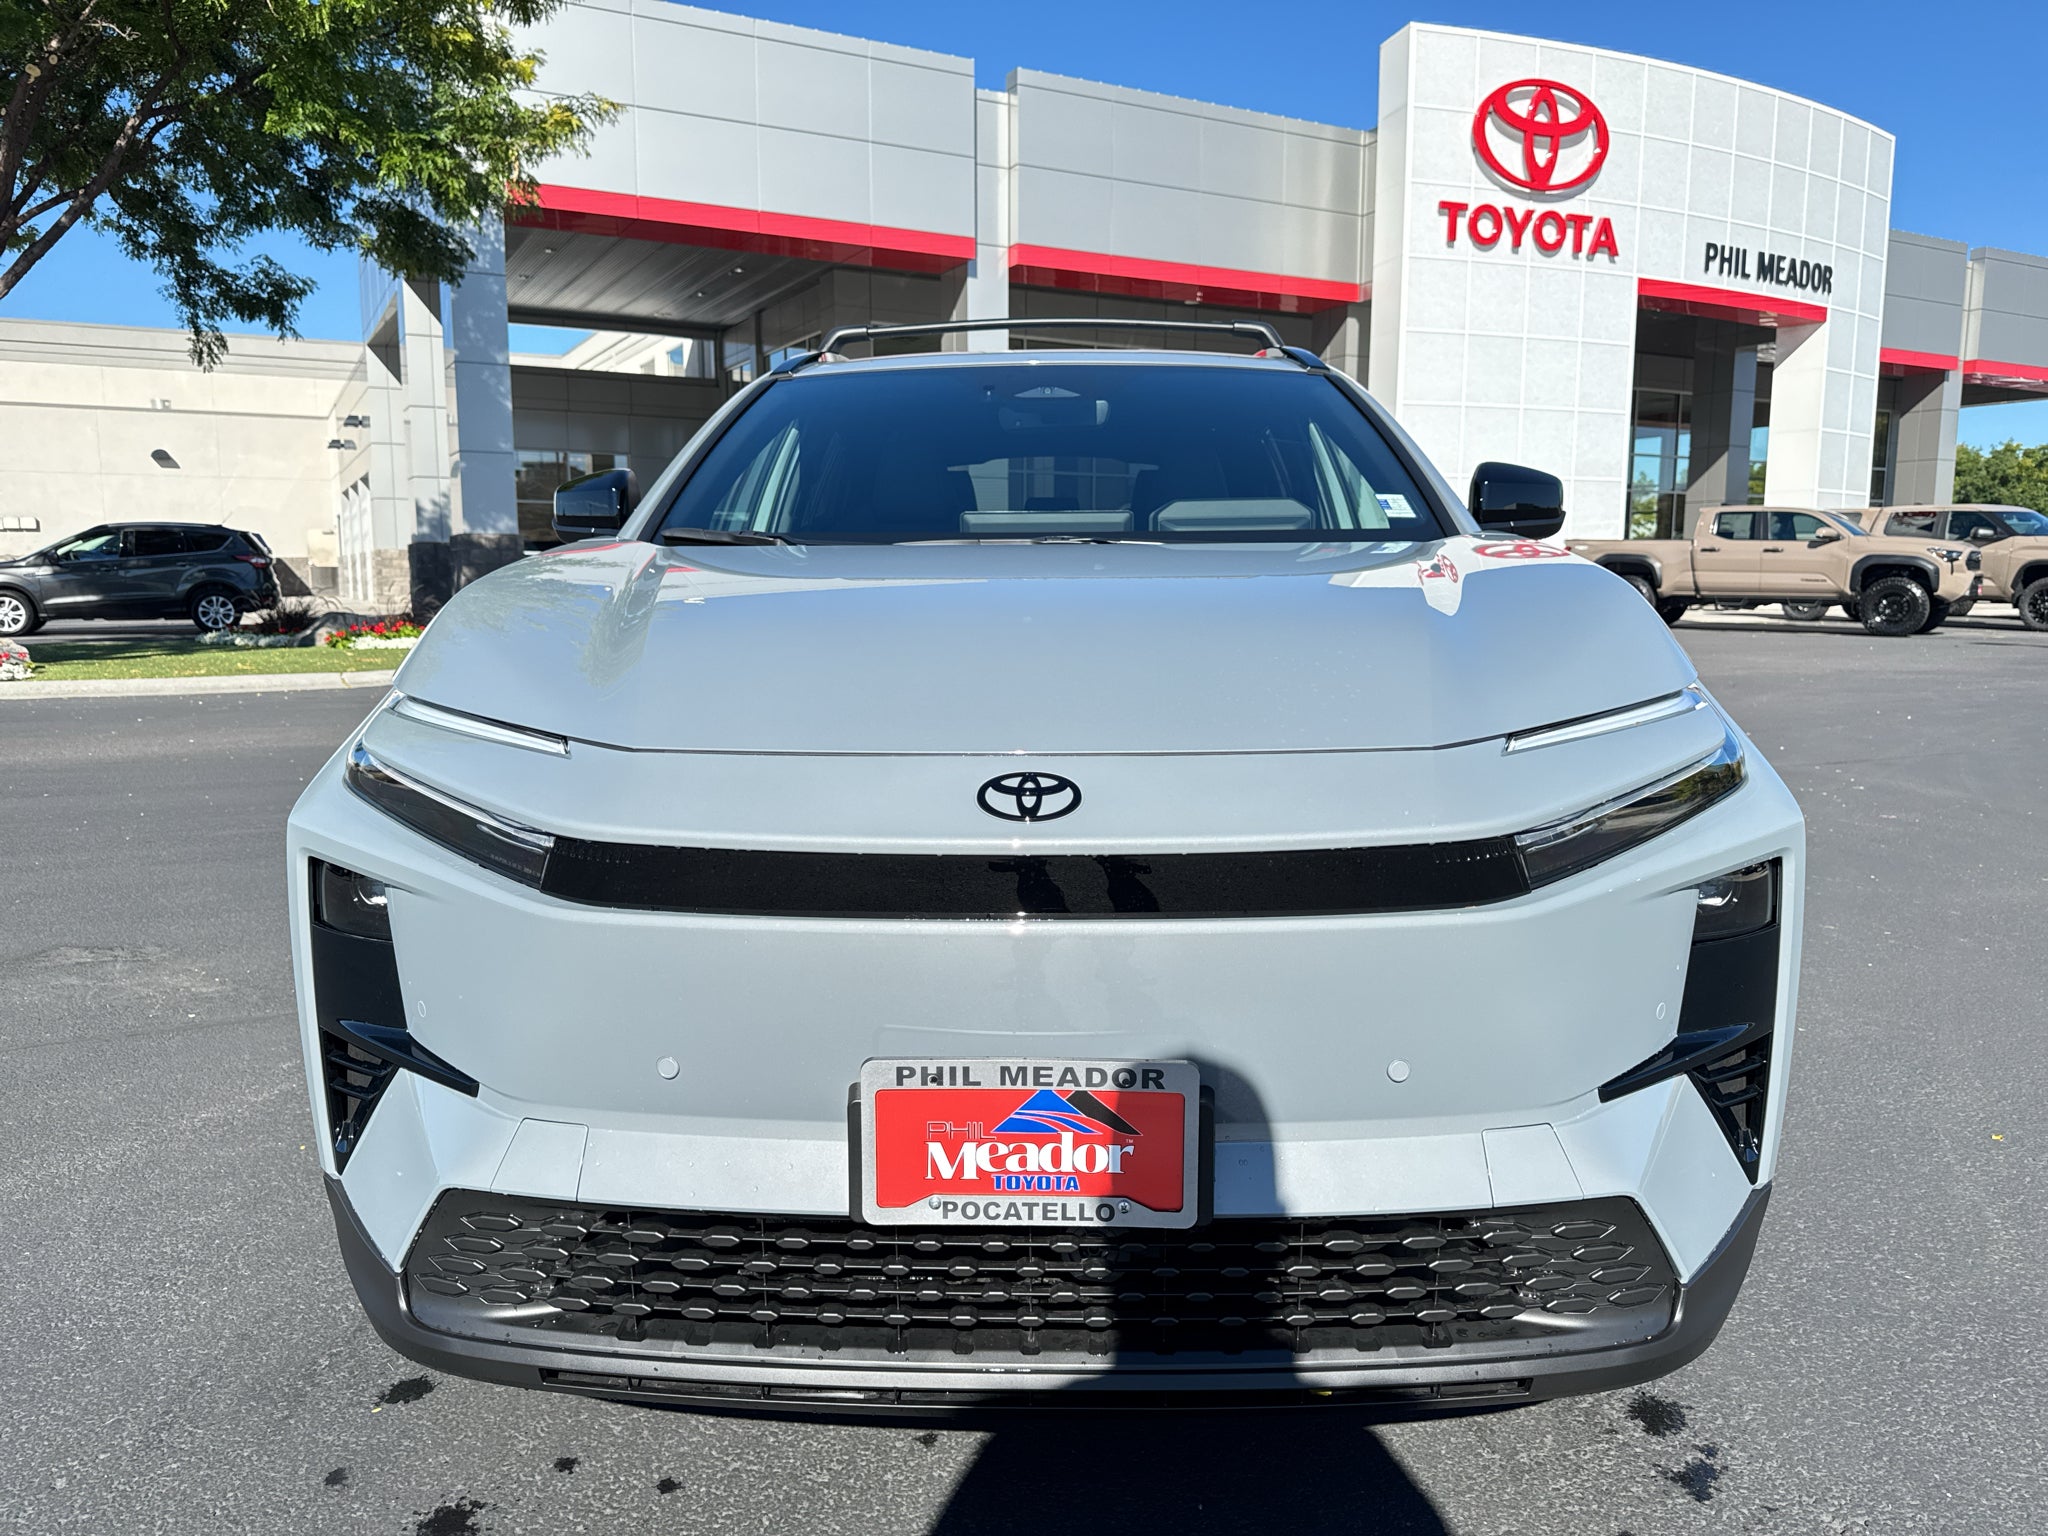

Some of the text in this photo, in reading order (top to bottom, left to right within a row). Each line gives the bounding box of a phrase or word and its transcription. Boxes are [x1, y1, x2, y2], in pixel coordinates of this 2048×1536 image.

[1439, 200, 1619, 258] TOYOTA
[1704, 242, 1833, 295] PHIL MEADOR
[895, 1065, 1166, 1090] PHIL MEADOR
[926, 1121, 997, 1140] PHIL
[924, 1131, 1135, 1180] Meador
[991, 1174, 1080, 1191] TOYOTA
[942, 1199, 1116, 1223] POCATELLO
